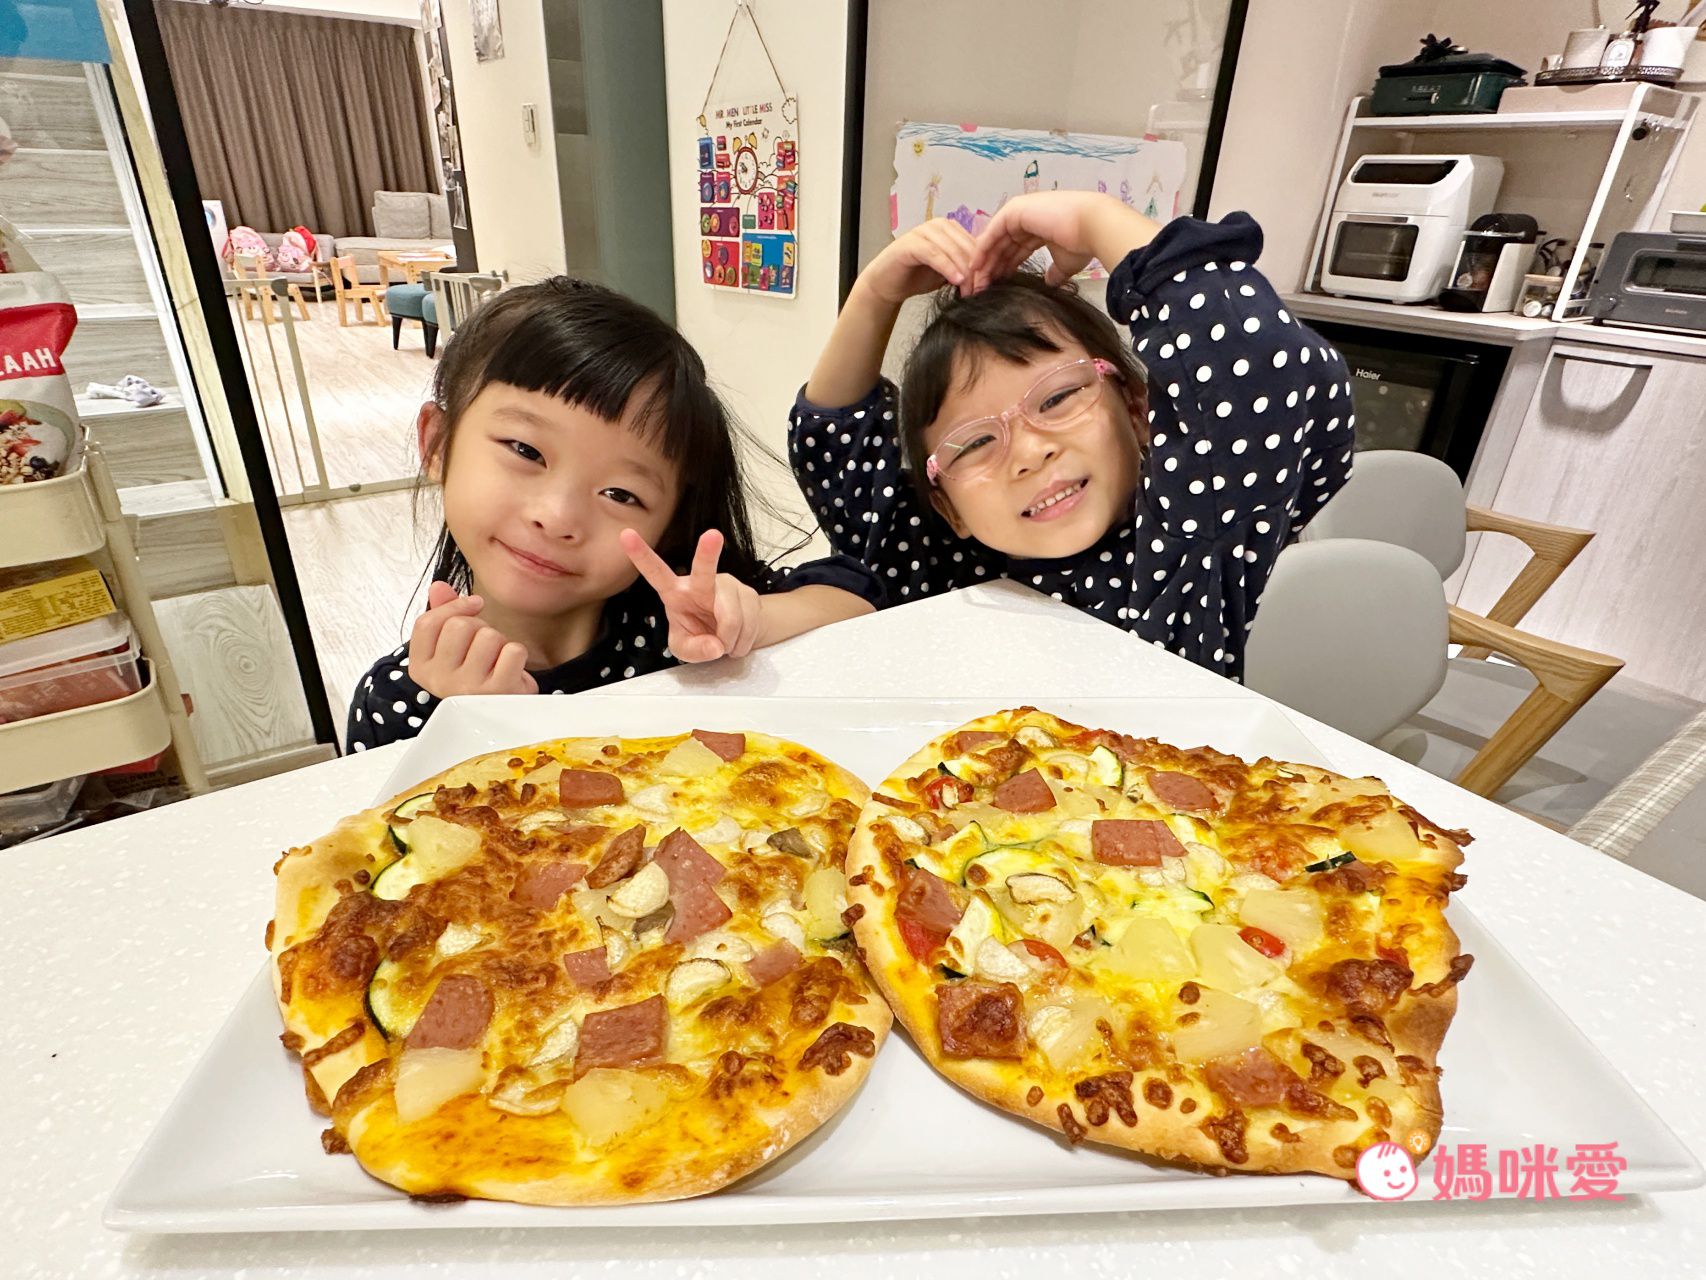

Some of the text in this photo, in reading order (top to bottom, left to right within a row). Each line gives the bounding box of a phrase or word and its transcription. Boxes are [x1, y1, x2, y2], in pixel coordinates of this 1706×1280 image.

[727, 107, 739, 117] MEN
[743, 104, 758, 115] LITTLE
[759, 102, 773, 113] MISS
[726, 116, 762, 130] My First Calendar
[0, 347, 57, 375] AAH
[1355, 368, 1381, 380] Haier
